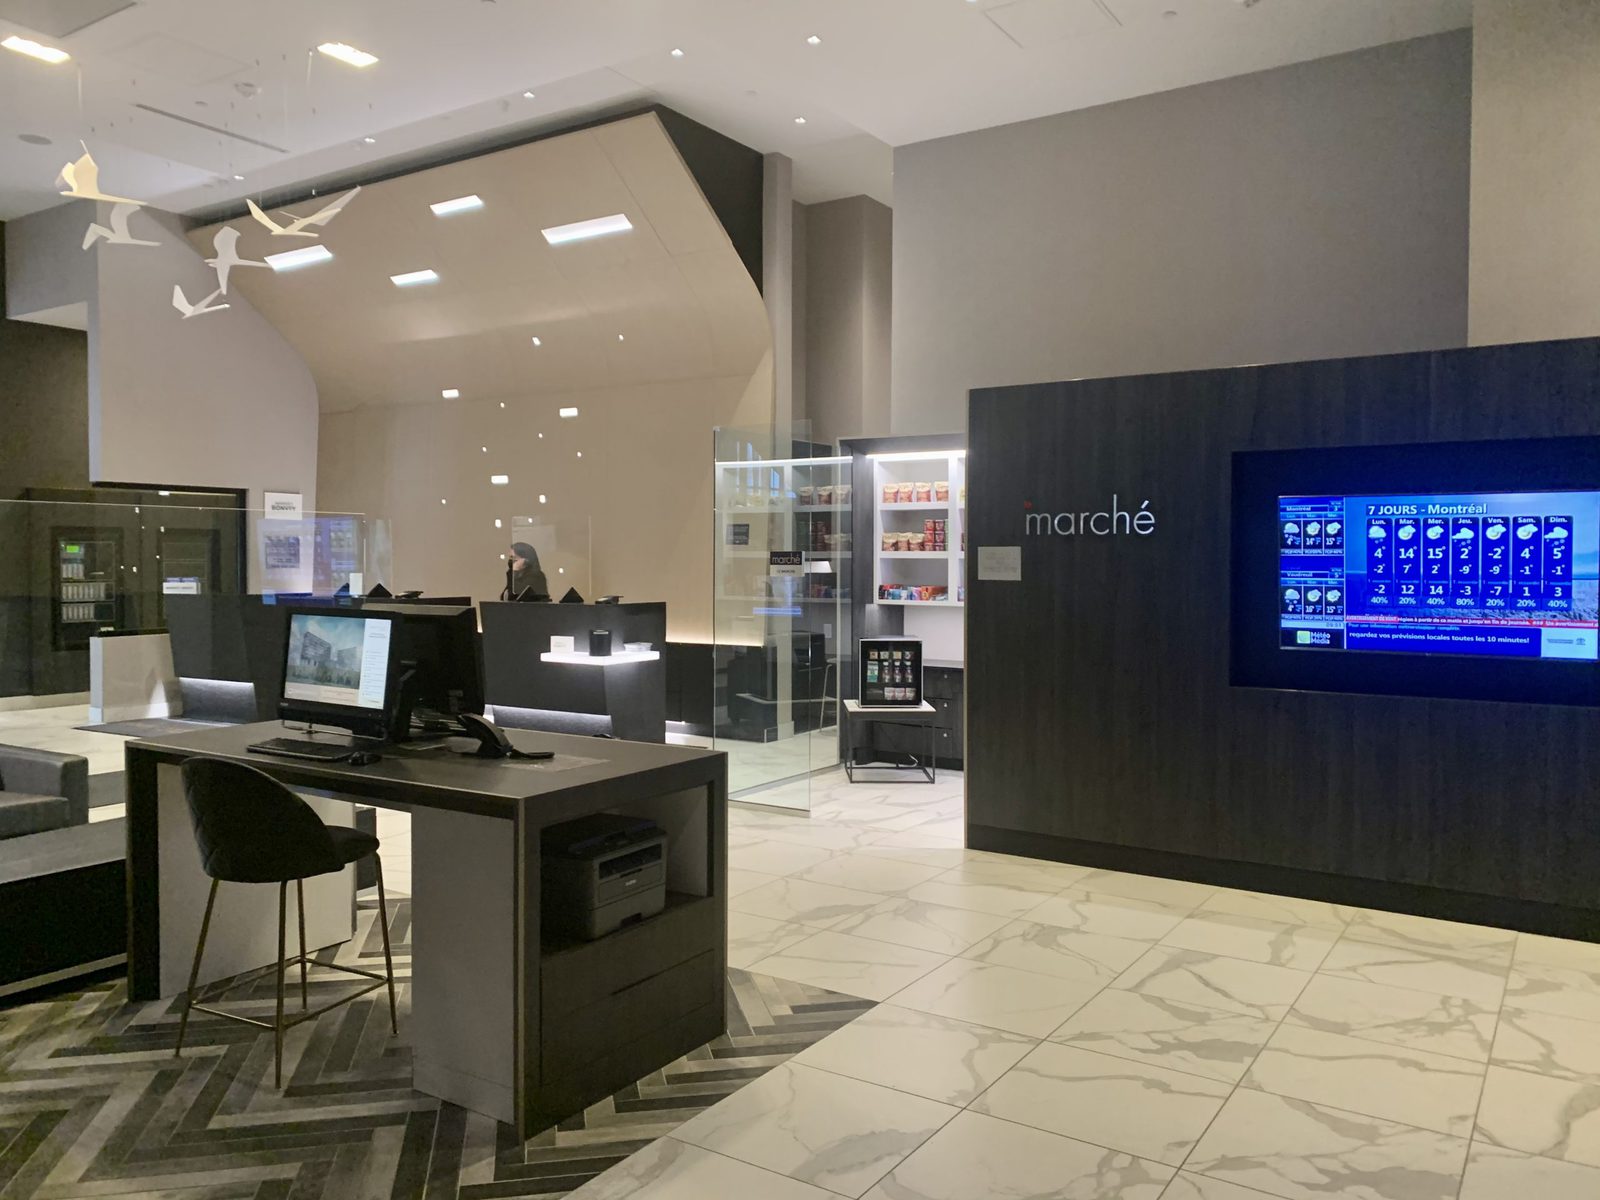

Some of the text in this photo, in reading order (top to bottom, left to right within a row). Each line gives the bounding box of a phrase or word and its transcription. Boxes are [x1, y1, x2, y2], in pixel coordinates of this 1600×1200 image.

[1024, 493, 1155, 535] marché
[1368, 505, 1376, 515] 7
[1378, 505, 1418, 515] JOURS
[1428, 503, 1487, 515] Montréal
[1374, 584, 1562, 597] -2 12 14 -3 -7 1 3
[1398, 596, 1416, 604] 20%
[1426, 597, 1445, 605] 40%
[1486, 598, 1505, 606] 20%
[1516, 599, 1536, 607] 20%
[1548, 600, 1568, 608] 40%
